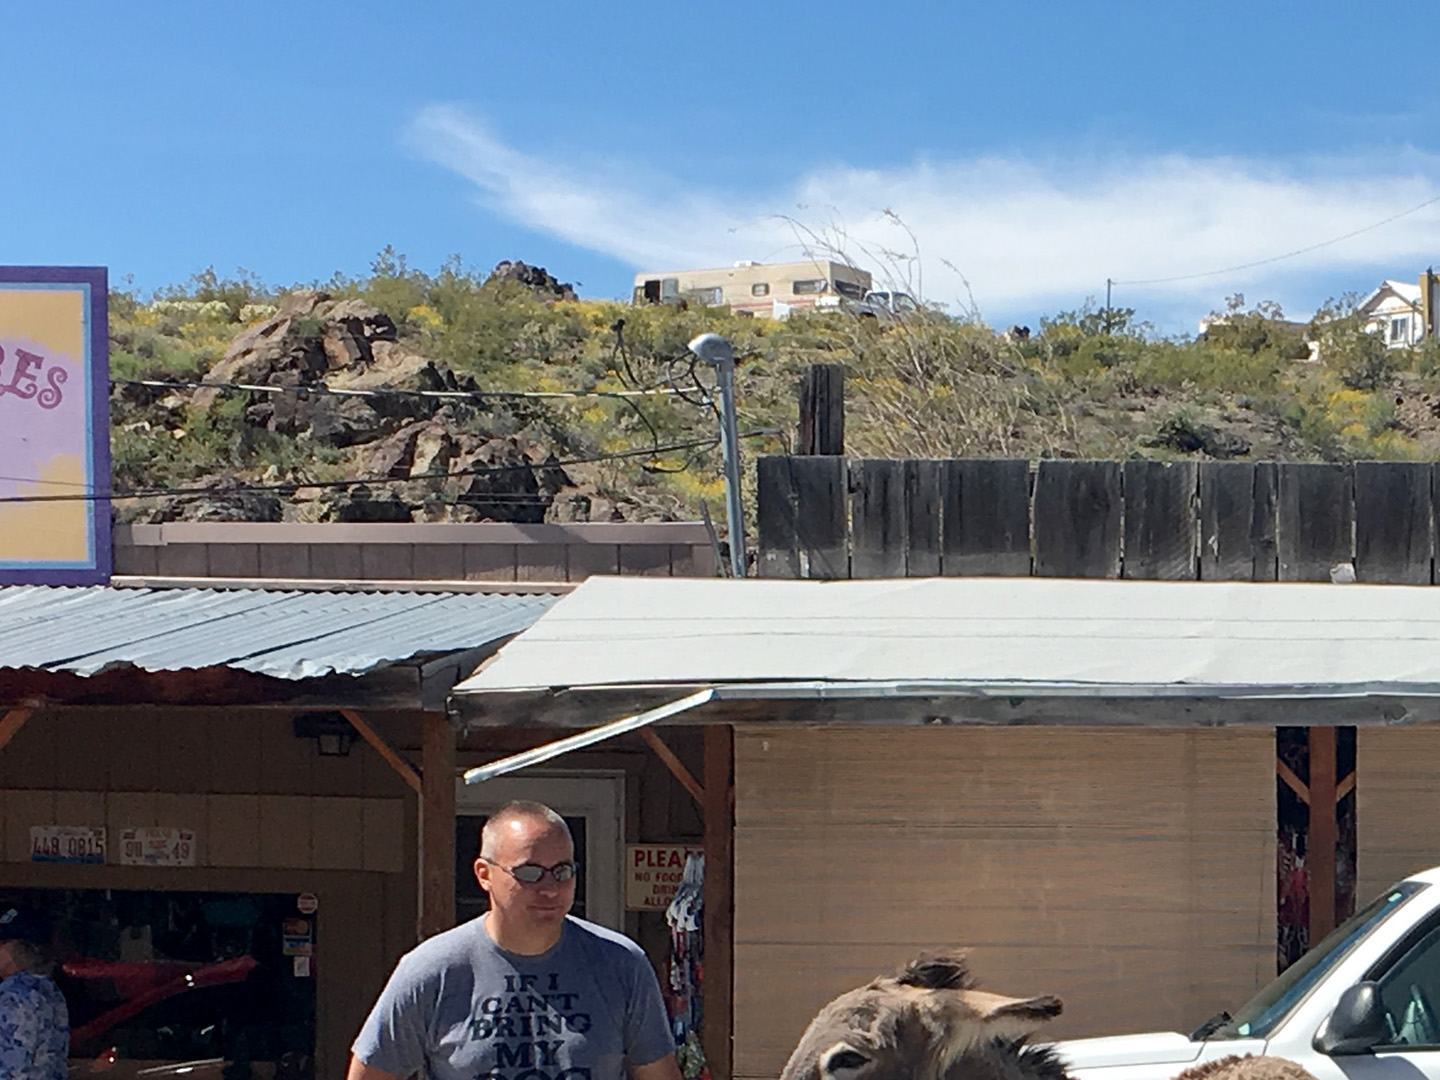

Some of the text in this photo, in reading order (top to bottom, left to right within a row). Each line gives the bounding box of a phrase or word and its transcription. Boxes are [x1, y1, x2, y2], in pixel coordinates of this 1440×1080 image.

[0, 345, 68, 409] ES
[634, 850, 705, 867] PLEA
[634, 872, 650, 882] NO
[653, 885, 679, 894] DRIN
[504, 973, 559, 992] IF I
[482, 993, 579, 1014] CAN'T
[471, 1013, 593, 1041] BRING
[493, 1040, 565, 1068] MY
